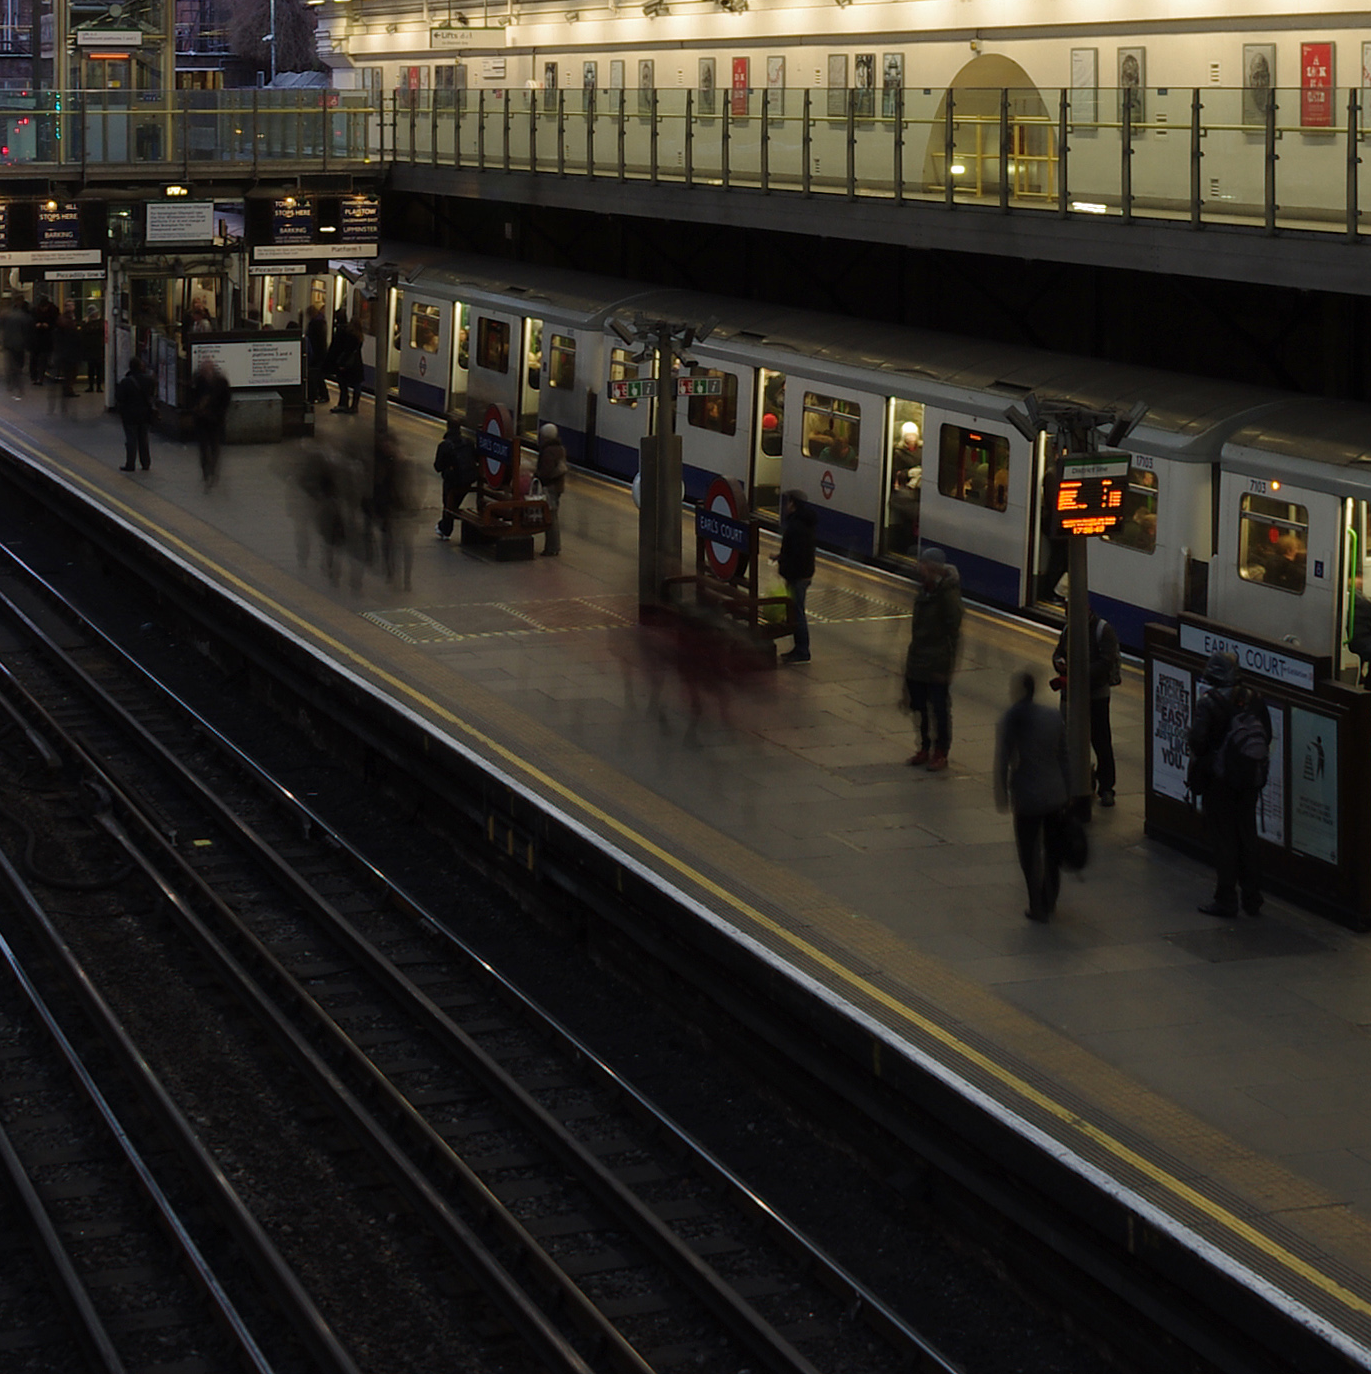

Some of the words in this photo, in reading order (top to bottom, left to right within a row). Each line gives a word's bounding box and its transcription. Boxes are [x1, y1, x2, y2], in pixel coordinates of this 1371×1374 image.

[61, 212, 78, 220] HERE
[44, 231, 74, 239] BARKING
[700, 515, 719, 535] EARL'S
[720, 523, 744, 544] COURT
[1246, 649, 1286, 677] COURT
